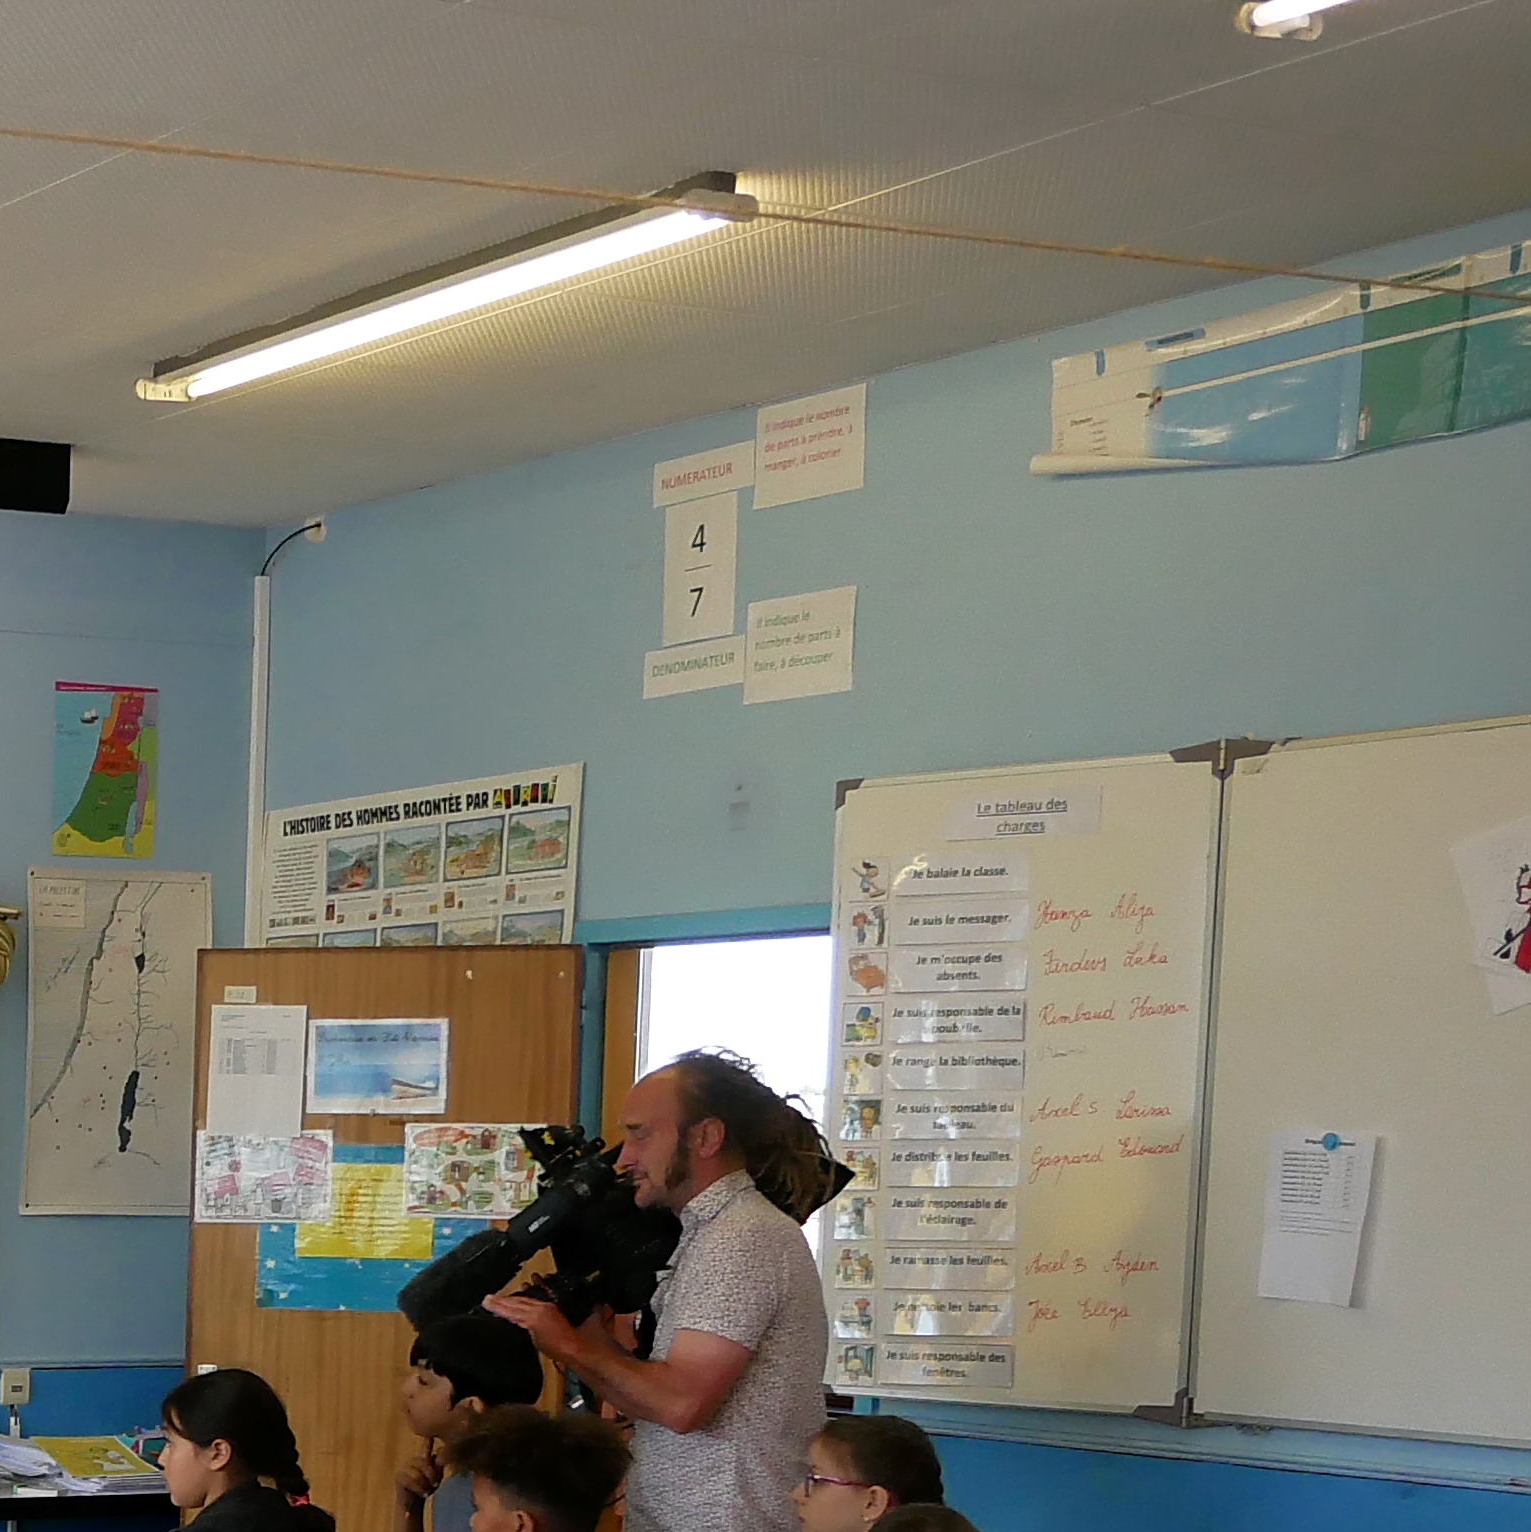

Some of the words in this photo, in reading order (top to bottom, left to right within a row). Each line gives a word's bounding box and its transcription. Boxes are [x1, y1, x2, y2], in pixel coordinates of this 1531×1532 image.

[691, 523, 707, 553] 4
[689, 587, 704, 618] 7
[283, 814, 332, 837] L'HISTOIRE
[334, 810, 354, 830] DES
[356, 804, 401, 826] HOMMES
[403, 793, 463, 819] RACONTÉE
[465, 790, 490, 811] PAR
[976, 801, 992, 815] Le
[995, 799, 1043, 814] tableau
[1045, 797, 1068, 812] des
[996, 818, 1046, 835] charges
[926, 866, 959, 879] balaie
[973, 865, 1009, 878] classe.
[908, 915, 921, 927] Je
[922, 914, 944, 927] suis
[957, 913, 1012, 929] messager.
[916, 955, 929, 967] Je
[983, 952, 1003, 964] des
